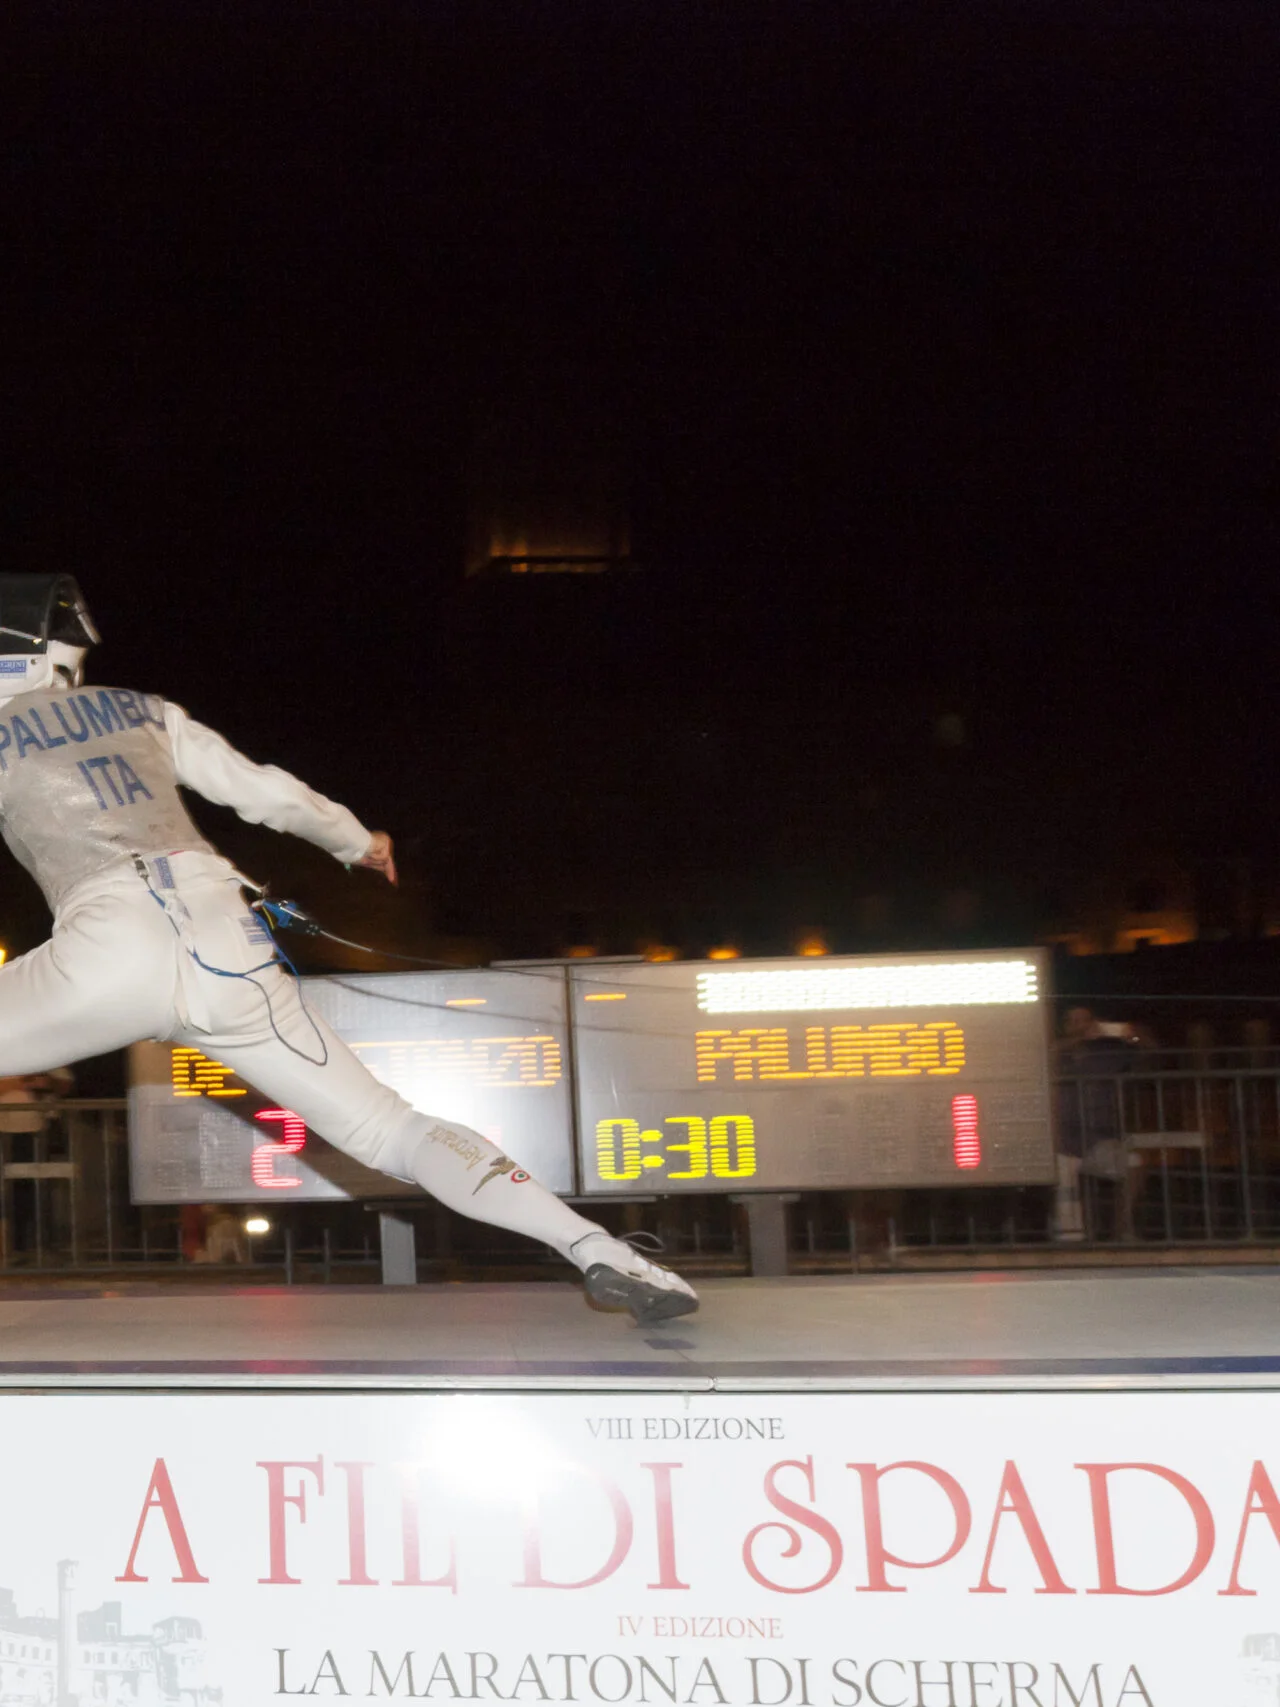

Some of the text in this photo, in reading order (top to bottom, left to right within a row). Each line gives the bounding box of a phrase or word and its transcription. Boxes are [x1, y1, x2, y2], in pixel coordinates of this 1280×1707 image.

[76, 754, 154, 810] ITA
[695, 1022, 966, 1081] PALUMBO
[251, 1108, 306, 1189] 2
[595, 1115, 757, 1180] 0:30
[951, 1094, 981, 1169] 1
[584, 1417, 786, 1440] VIII EDIZIONE
[114, 1454, 1280, 1597] A FIL DI SPADA
[617, 1615, 784, 1639] IV EDIZIONE
[274, 1648, 1155, 1707] LA MARATONA DI SCHERMA
